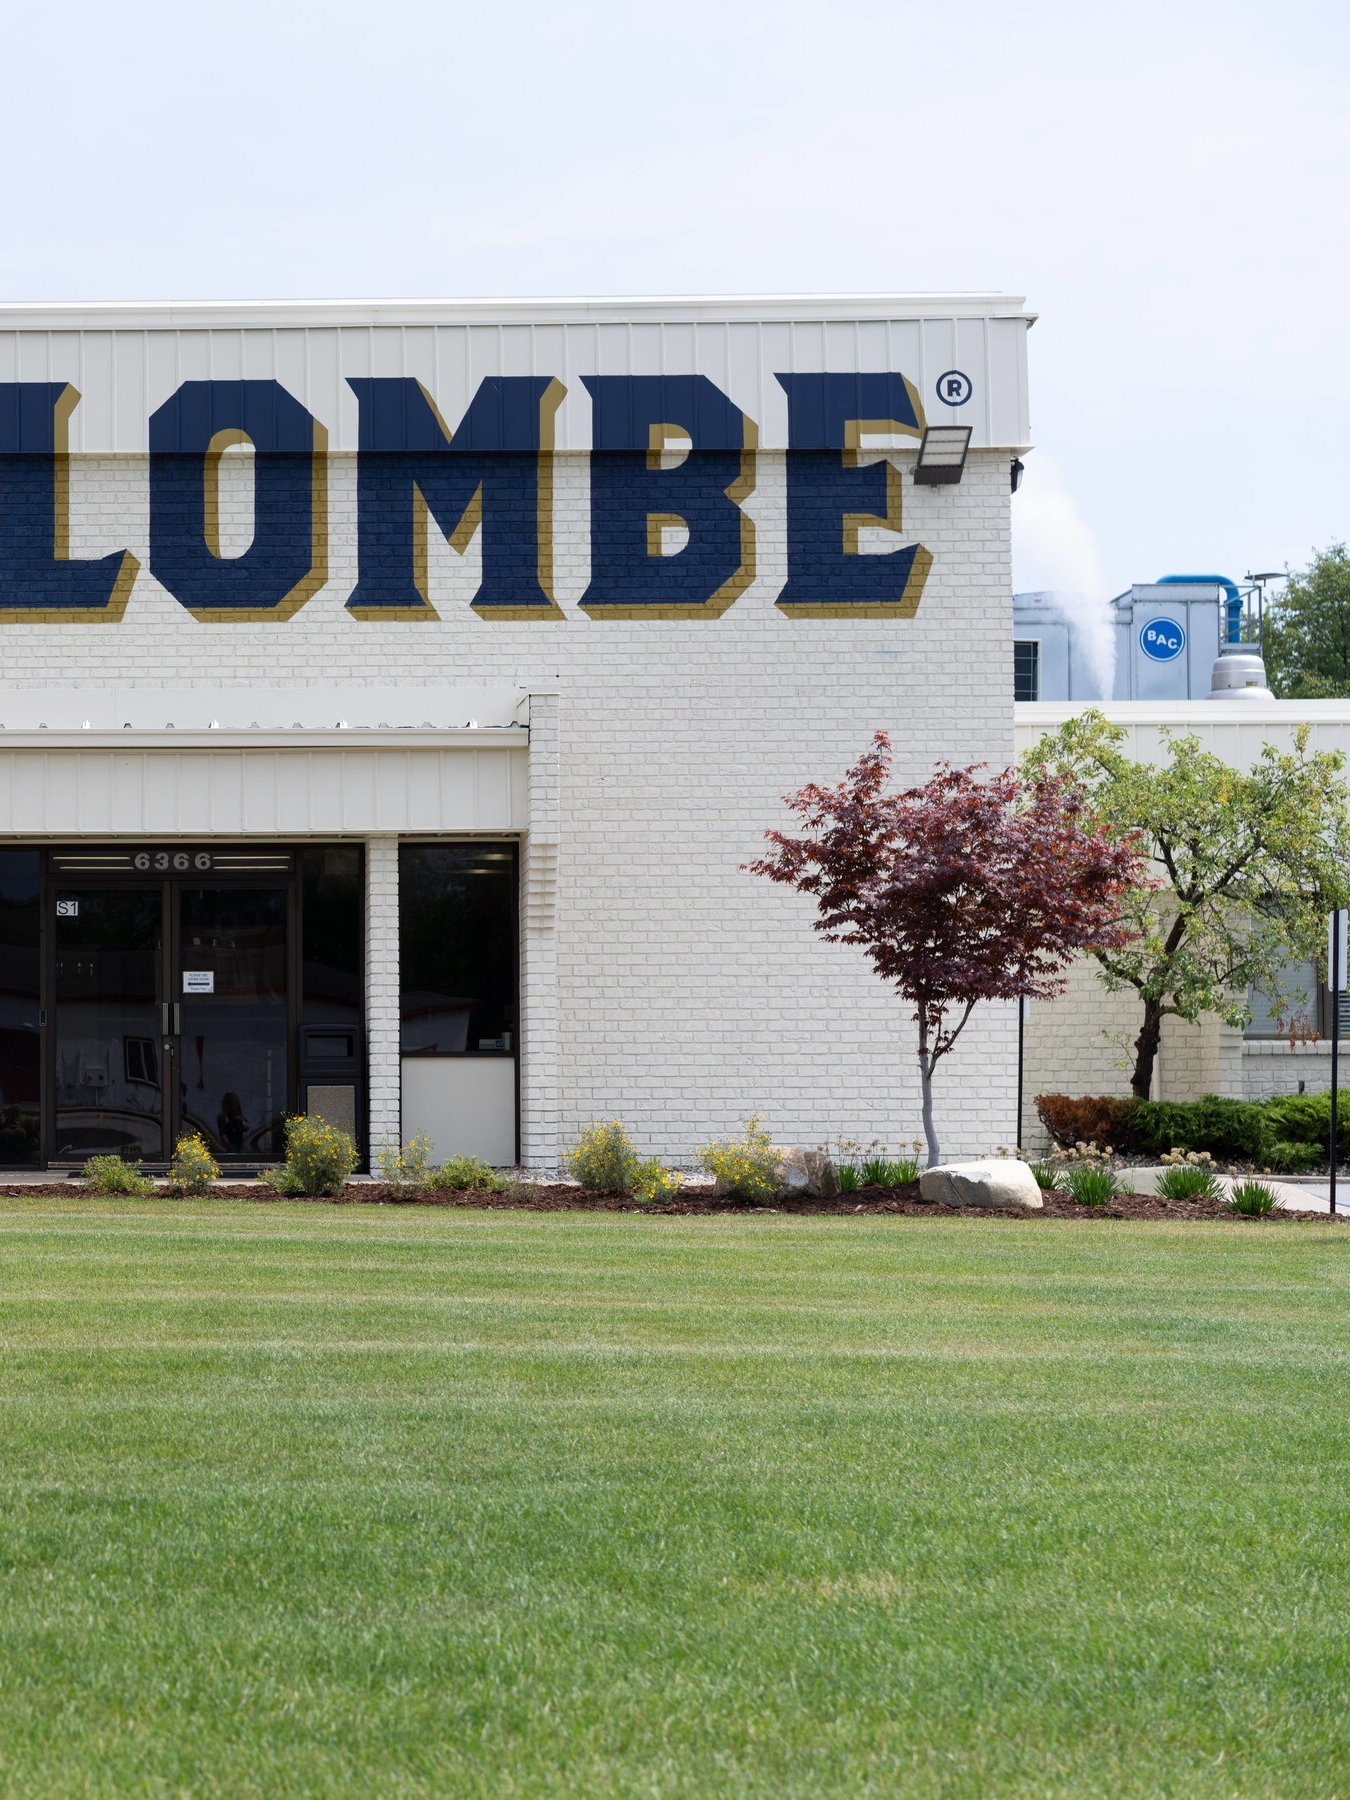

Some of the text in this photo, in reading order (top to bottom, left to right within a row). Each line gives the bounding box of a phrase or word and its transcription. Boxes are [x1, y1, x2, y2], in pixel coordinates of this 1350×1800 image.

[1147, 630, 1178, 649] BAC
[134, 852, 211, 870] 6366
[58, 901, 76, 915] S1
